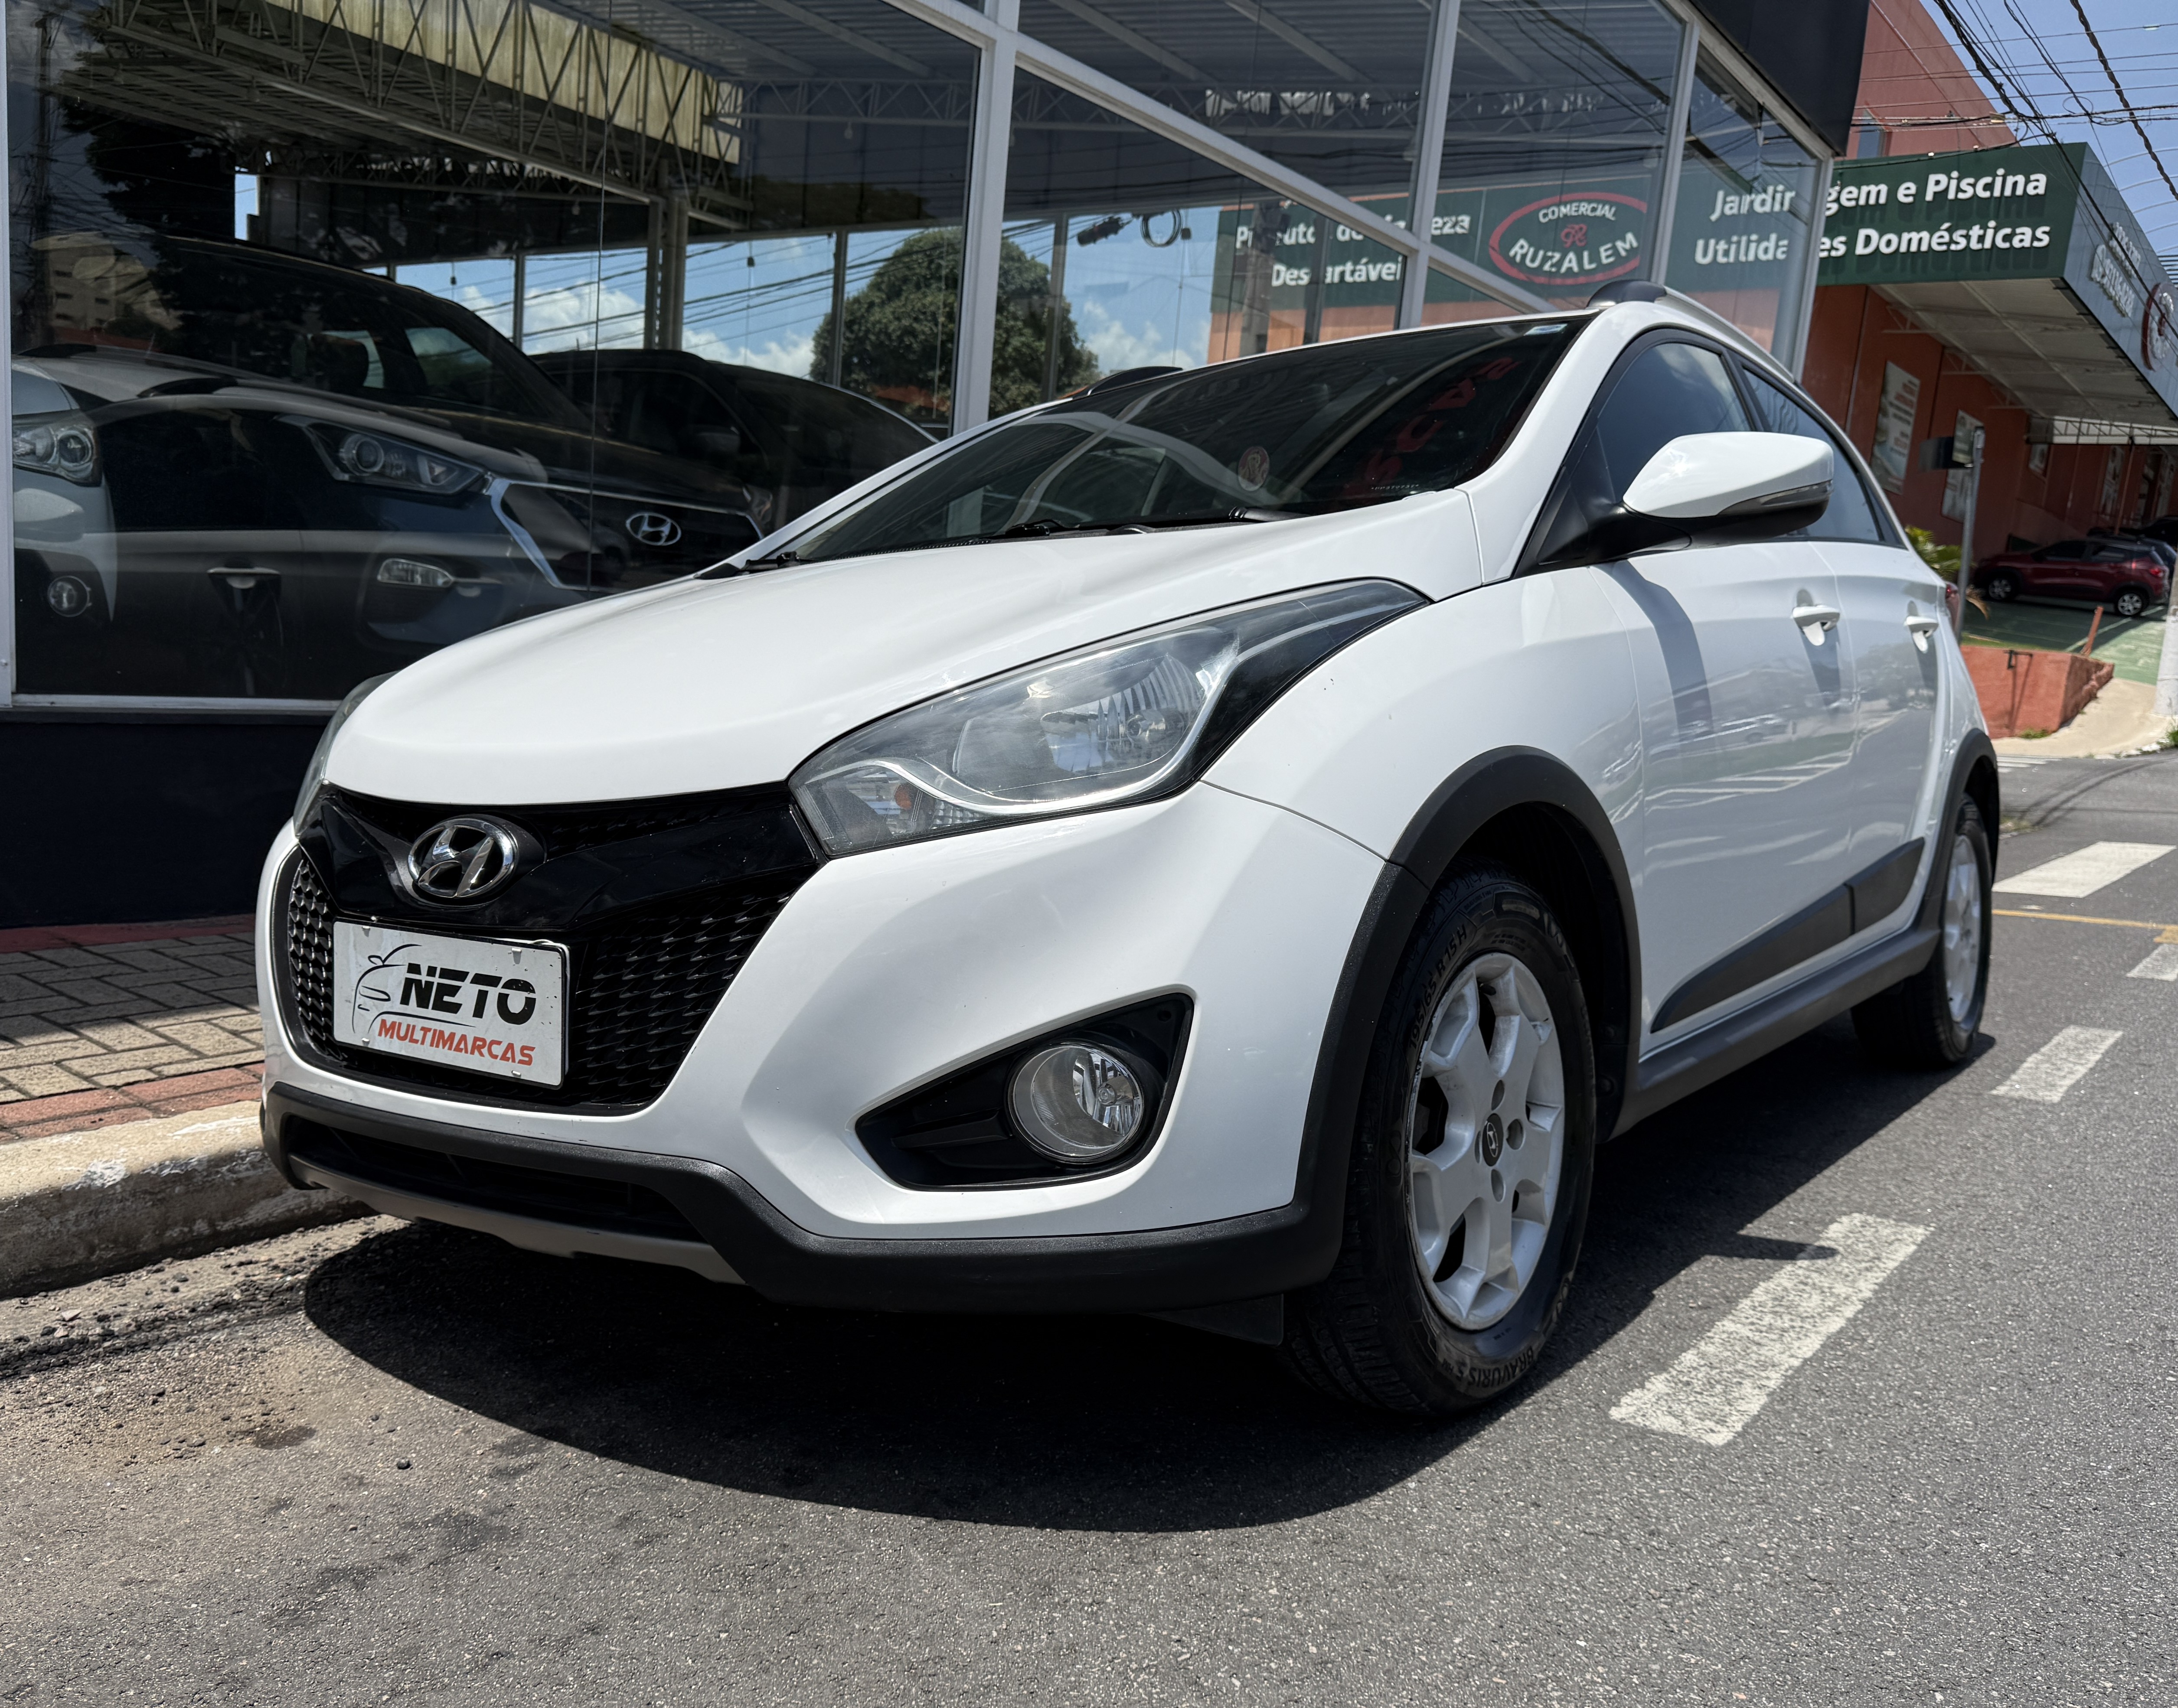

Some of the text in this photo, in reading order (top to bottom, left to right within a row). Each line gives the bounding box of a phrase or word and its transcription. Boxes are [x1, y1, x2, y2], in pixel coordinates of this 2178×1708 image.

[1897, 182, 1917, 203] e
[1925, 168, 2047, 201] Piscina
[1539, 202, 1616, 223] COMERCIAL
[1509, 231, 1639, 274] RUZALEM
[1855, 220, 2050, 255] Domésticas
[399, 963, 536, 1025] NETO
[378, 1019, 536, 1066] MULTIMARCAS
[1467, 1345, 1534, 1389] BRAVURIS
